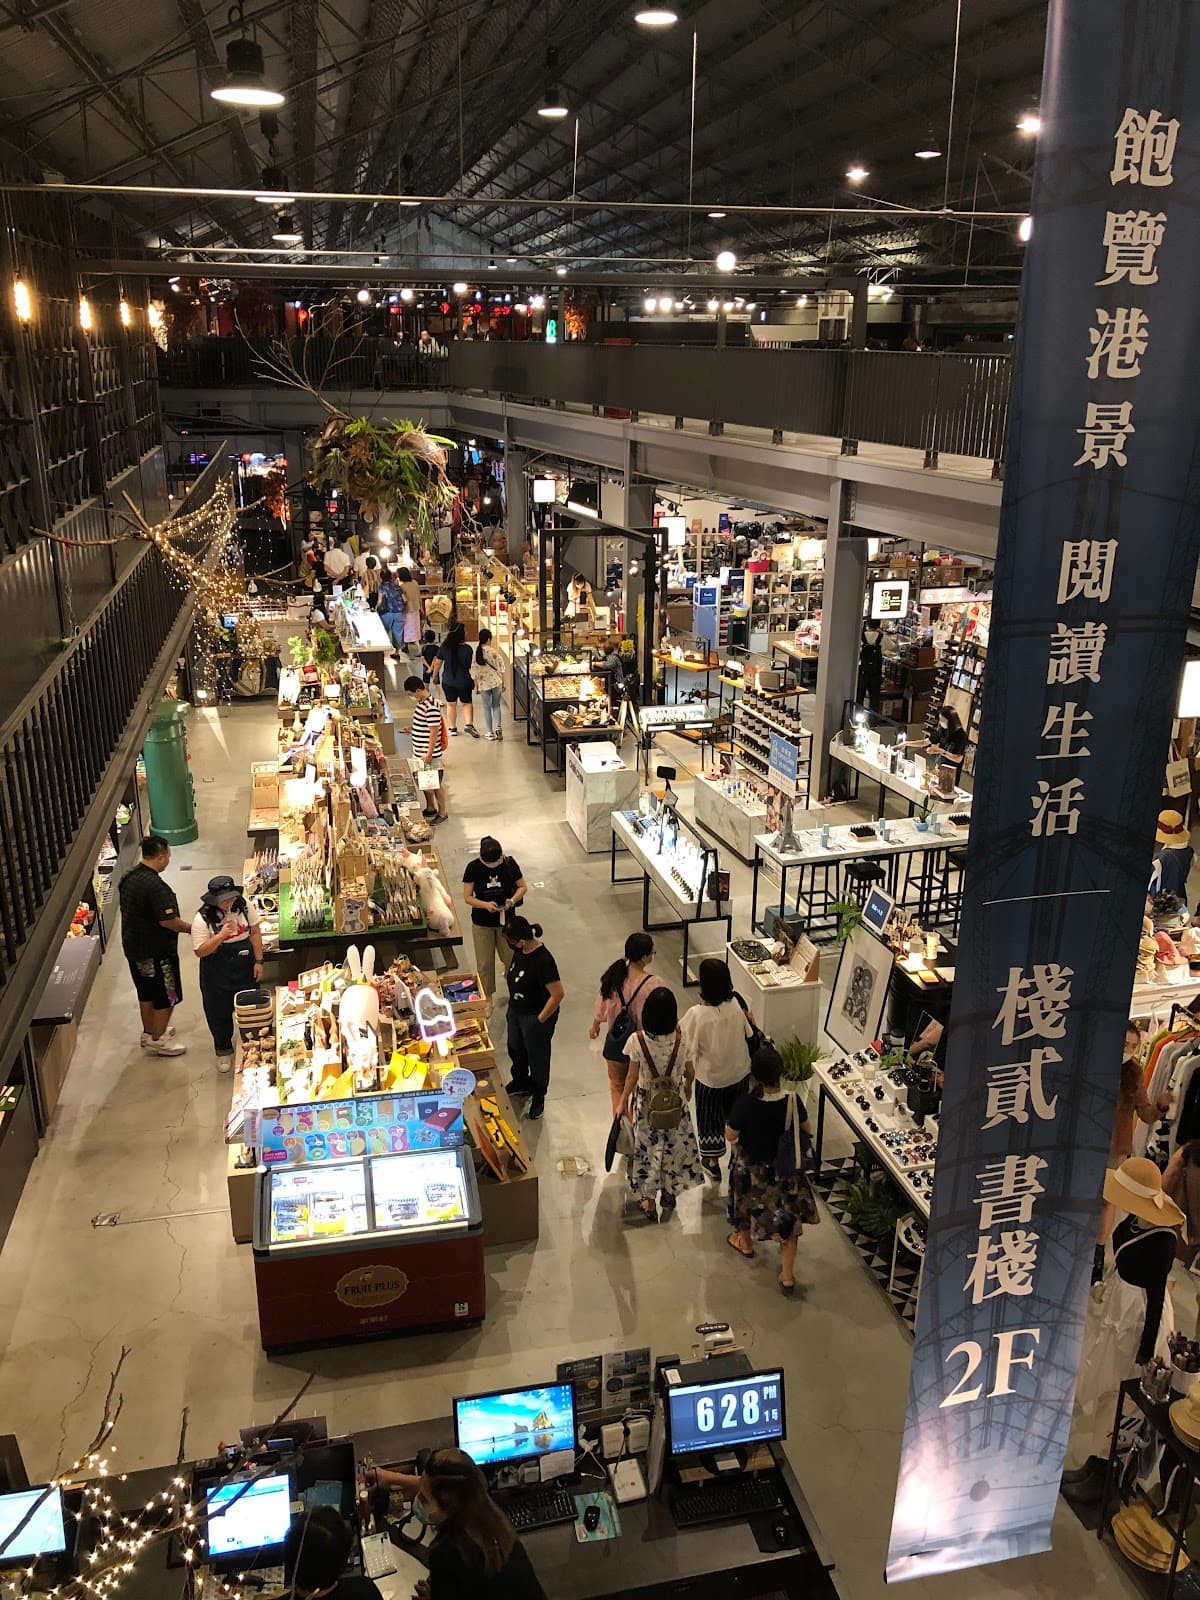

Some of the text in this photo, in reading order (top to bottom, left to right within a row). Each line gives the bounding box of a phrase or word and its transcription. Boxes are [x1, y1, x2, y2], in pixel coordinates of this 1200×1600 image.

[1029, 107, 1180, 838] 飽覽港景 閱讀生活
[763, 1384, 777, 1401] PM
[938, 1327, 1041, 1410] 2F
